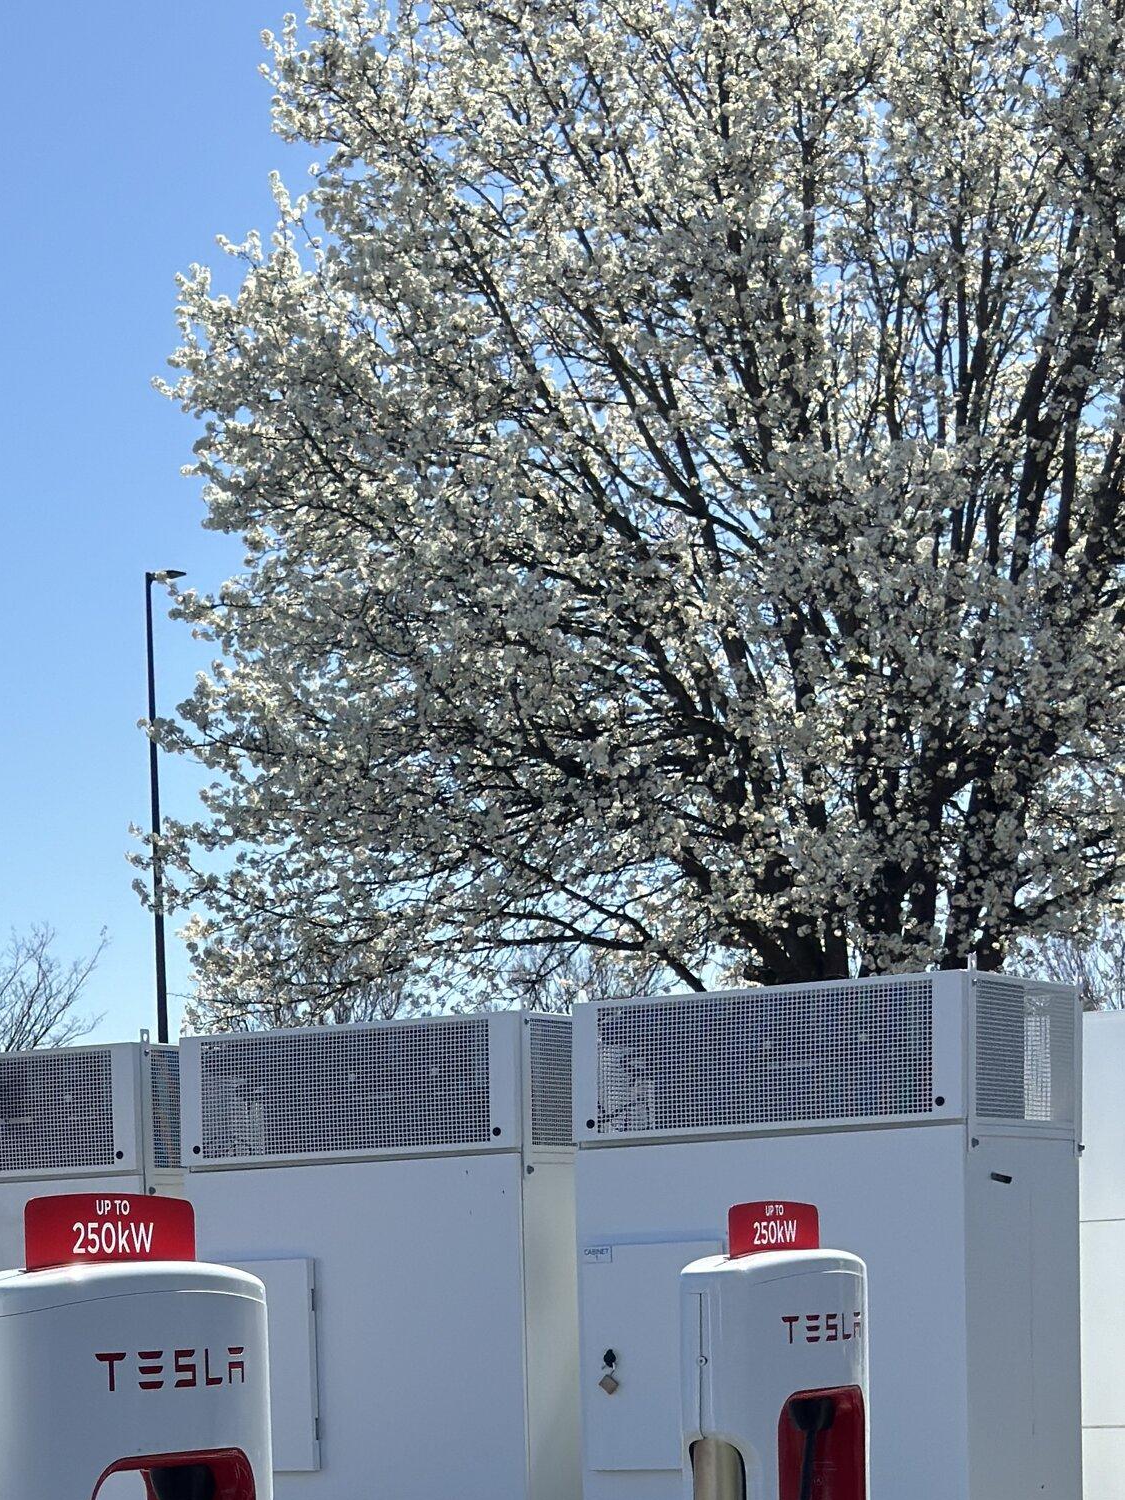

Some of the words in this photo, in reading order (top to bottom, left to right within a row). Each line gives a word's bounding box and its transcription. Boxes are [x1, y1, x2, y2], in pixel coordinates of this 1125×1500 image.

[96, 1200, 112, 1215] UP
[114, 1200, 131, 1215] TO
[765, 1206, 775, 1216] UP
[775, 1205, 784, 1216] TO
[72, 1221, 154, 1254] 250kW
[753, 1220, 797, 1245] 250kW
[781, 1311, 861, 1344] TESLA
[95, 1346, 245, 1391] TESLA
